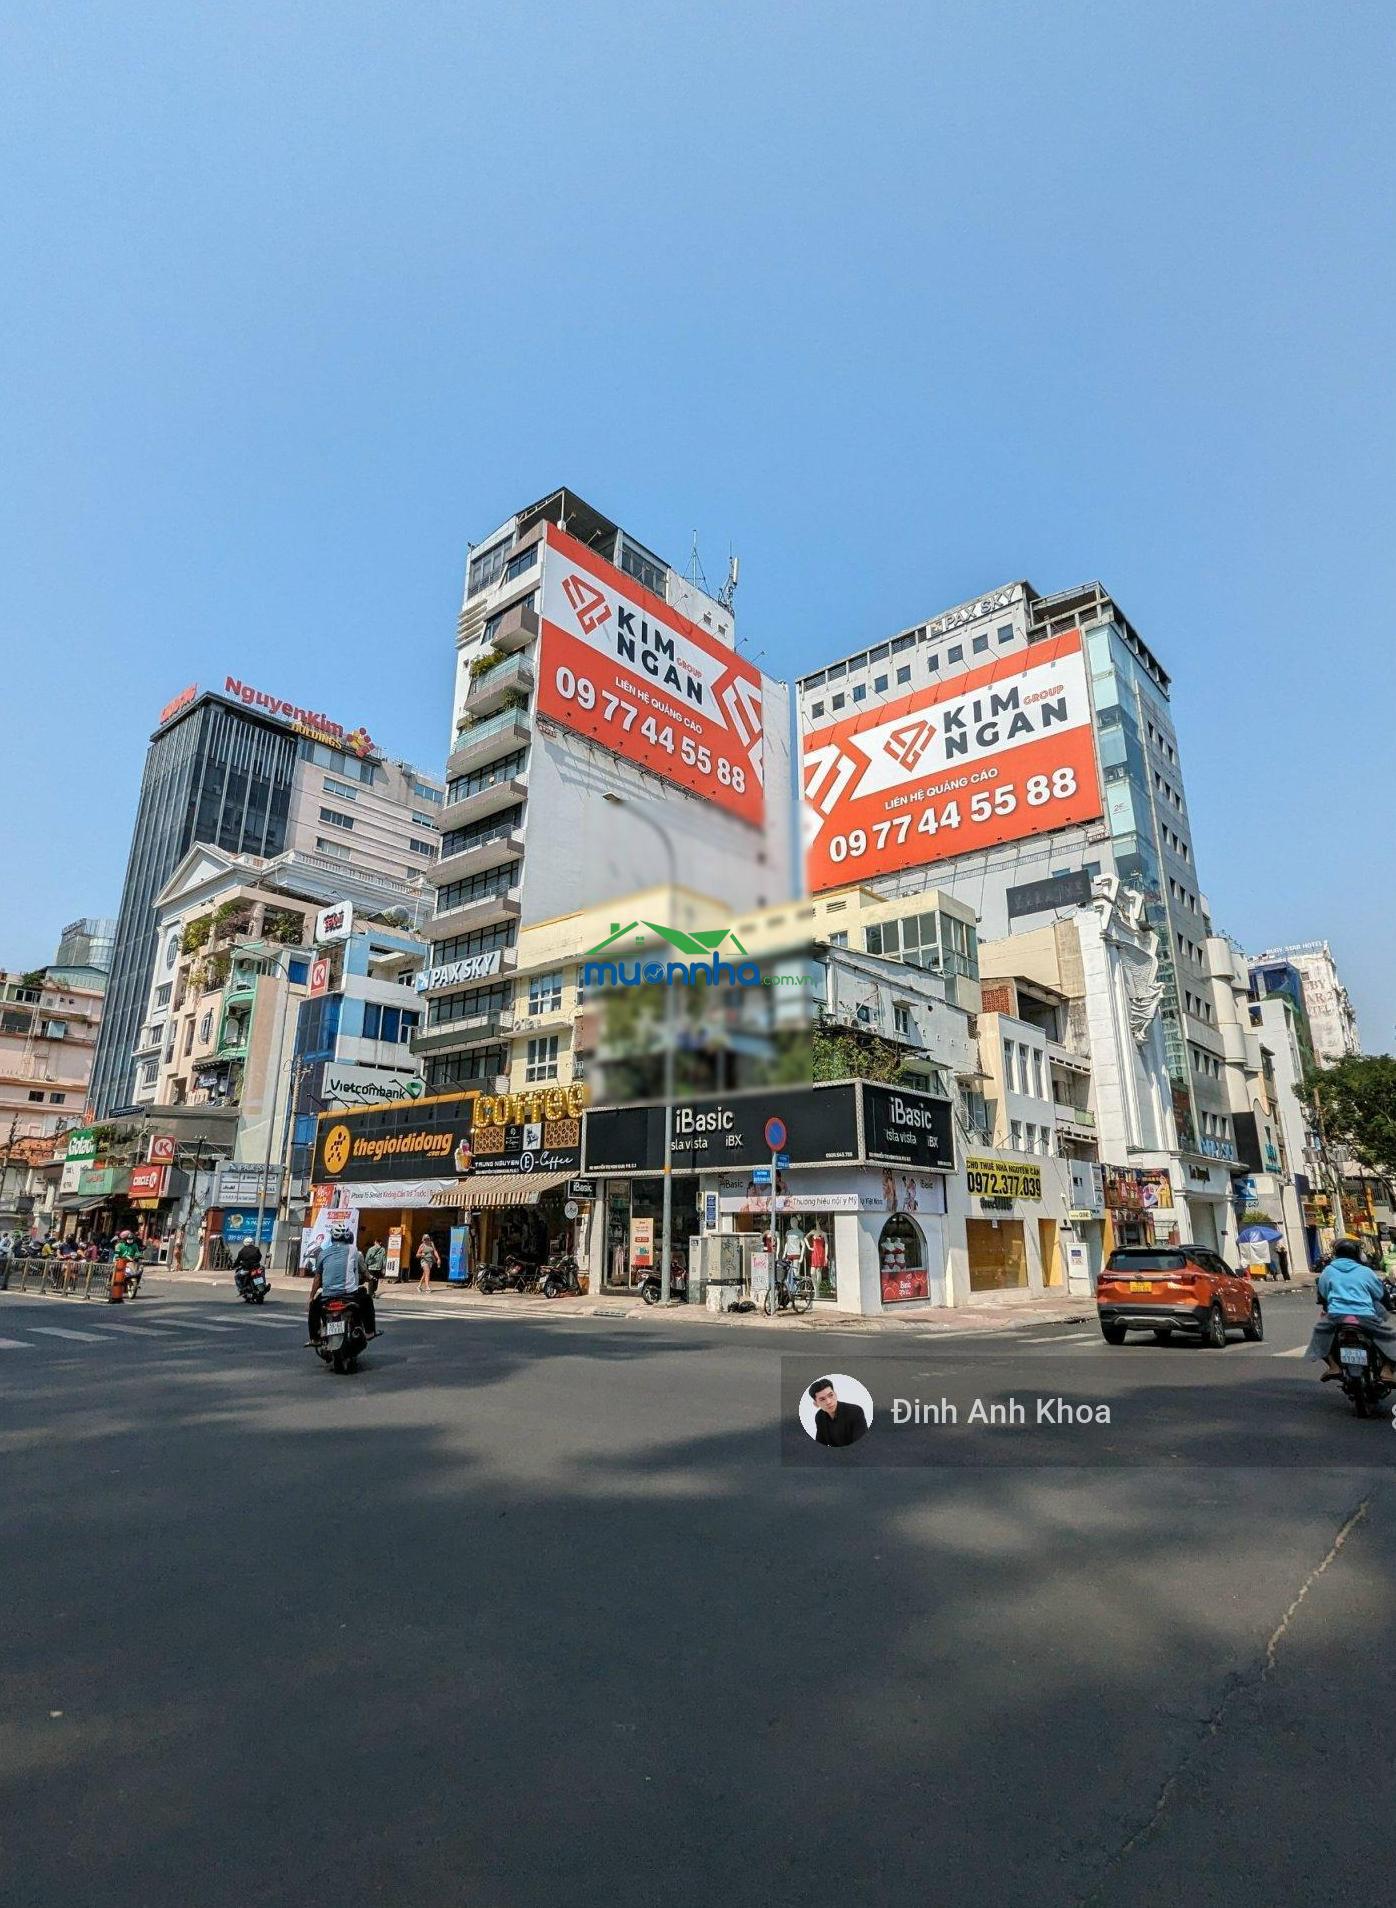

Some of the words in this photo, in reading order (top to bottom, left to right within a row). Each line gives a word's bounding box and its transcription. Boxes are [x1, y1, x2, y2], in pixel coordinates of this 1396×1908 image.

[944, 605, 977, 630] PAX
[980, 588, 1015, 614] SKY
[617, 605, 675, 662] KIM
[616, 633, 703, 706] NGAN
[676, 657, 704, 679] GROUP
[942, 685, 1021, 735] KIM
[1022, 684, 1065, 706] GROUP
[554, 666, 596, 711] 09
[601, 689, 639, 732] 77
[640, 715, 675, 755] 44
[680, 736, 712, 775] 55
[717, 756, 746, 794] 88
[943, 696, 1069, 761] NGAN
[884, 794, 908, 811] LIÊN
[909, 789, 926, 804] HỆ
[926, 776, 969, 799] QUẢNG
[970, 767, 999, 785] CÁO
[828, 828, 867, 864] 09
[872, 814, 912, 850] 77
[917, 800, 962, 837] 44
[970, 784, 1018, 824] 55
[1025, 766, 1078, 806] 88
[330, 1078, 406, 1100] Vietcombank
[675, 1105, 734, 1134] iBasic
[889, 1096, 932, 1130] iBasic
[353, 1131, 453, 1161] thegioididong
[671, 1138, 684, 1151] sla
[725, 1133, 744, 1147] iBX
[966, 1160, 979, 1169] CHO
[132, 1175, 149, 1186] CIRCLE
[573, 1181, 593, 1192] iBasic
[967, 1171, 1041, 1197] 0972.377.039
